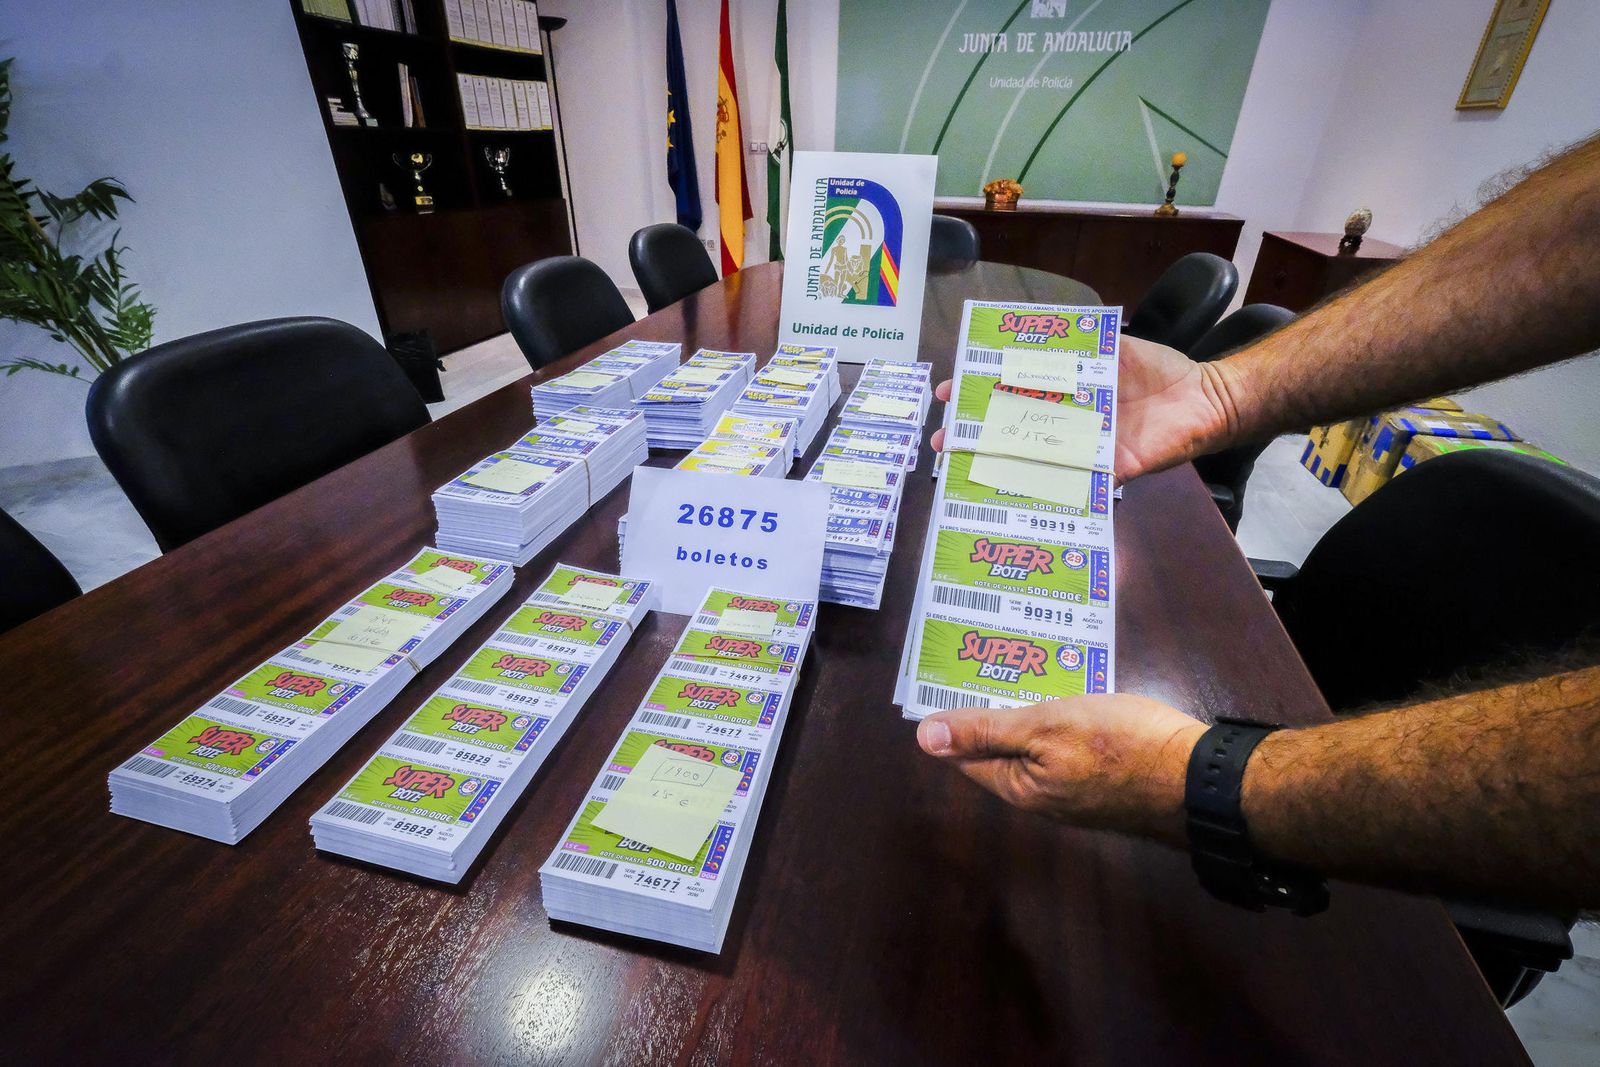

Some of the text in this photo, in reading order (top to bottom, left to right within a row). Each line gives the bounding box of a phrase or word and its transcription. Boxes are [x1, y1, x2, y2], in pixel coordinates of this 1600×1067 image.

[959, 31, 1132, 53] JUNTA DE ANDALUCIA
[990, 76, 1024, 88] Unidad
[1028, 77, 1039, 88] de
[807, 178, 828, 300] JUNTA DE ANDALUCIA
[793, 322, 837, 336] Unidad
[842, 326, 857, 337] de
[999, 312, 1070, 338] SUPER
[1081, 319, 1093, 327] 29
[1014, 332, 1049, 344] BOTE
[1076, 392, 1089, 400] 29
[540, 435, 576, 446] BOLETO
[852, 430, 888, 438] BOLETO
[1032, 502, 1084, 516] 500.000€
[677, 503, 778, 533] 26875
[1030, 518, 1075, 532] 90319
[960, 527, 1002, 536] DISCAPACITADO
[1078, 543, 1109, 552] APOYANOS
[676, 546, 768, 570] boletos
[970, 538, 1054, 574] SUPER
[1068, 552, 1082, 563] 29
[988, 564, 1029, 581] BOTE
[384, 589, 435, 606] SUPER
[1004, 584, 1024, 593] HASTA
[1027, 586, 1082, 602] 500.000€
[388, 600, 412, 608] BOTE
[728, 596, 780, 613] SUPER
[532, 612, 588, 632] SUPER
[1024, 606, 1073, 624] 90319
[540, 624, 565, 634] BOTE
[948, 616, 994, 630] DISCAPACITADO
[1057, 634, 1073, 643] ERES
[1074, 638, 1108, 648] APOYANOS
[705, 636, 762, 658] SUPER
[958, 630, 1048, 677] SUPER
[1062, 650, 1078, 663] 29
[491, 654, 552, 677] SUPER
[976, 662, 1023, 684] BOTE
[499, 669, 528, 680] BOTE
[730, 671, 762, 682] 74677
[265, 672, 327, 697] SUPER
[962, 681, 1016, 696] BOTE DE HASTA
[267, 687, 301, 700] BOTE
[506, 694, 539, 705] 85829
[678, 683, 741, 707] SUPER
[688, 699, 720, 711] BOTE
[264, 713, 296, 728] 69374
[442, 703, 508, 732] SUPER
[712, 714, 752, 726] 500.000€
[449, 721, 483, 735] BOTE
[706, 725, 742, 736] 74677
[187, 726, 256, 756] SUPER
[189, 746, 221, 760] BOTE
[455, 750, 491, 764] 85829
[726, 754, 737, 762] 29
[182, 774, 217, 788] 69374
[383, 765, 456, 799] SUPER
[388, 787, 427, 803] BOTE
[411, 807, 453, 822] 500.000€
[393, 821, 433, 836] 85829
[600, 850, 615, 858] BOTE
[625, 856, 644, 864] HASTA
[646, 858, 696, 874] 500.000€
[635, 874, 680, 890] 74677
